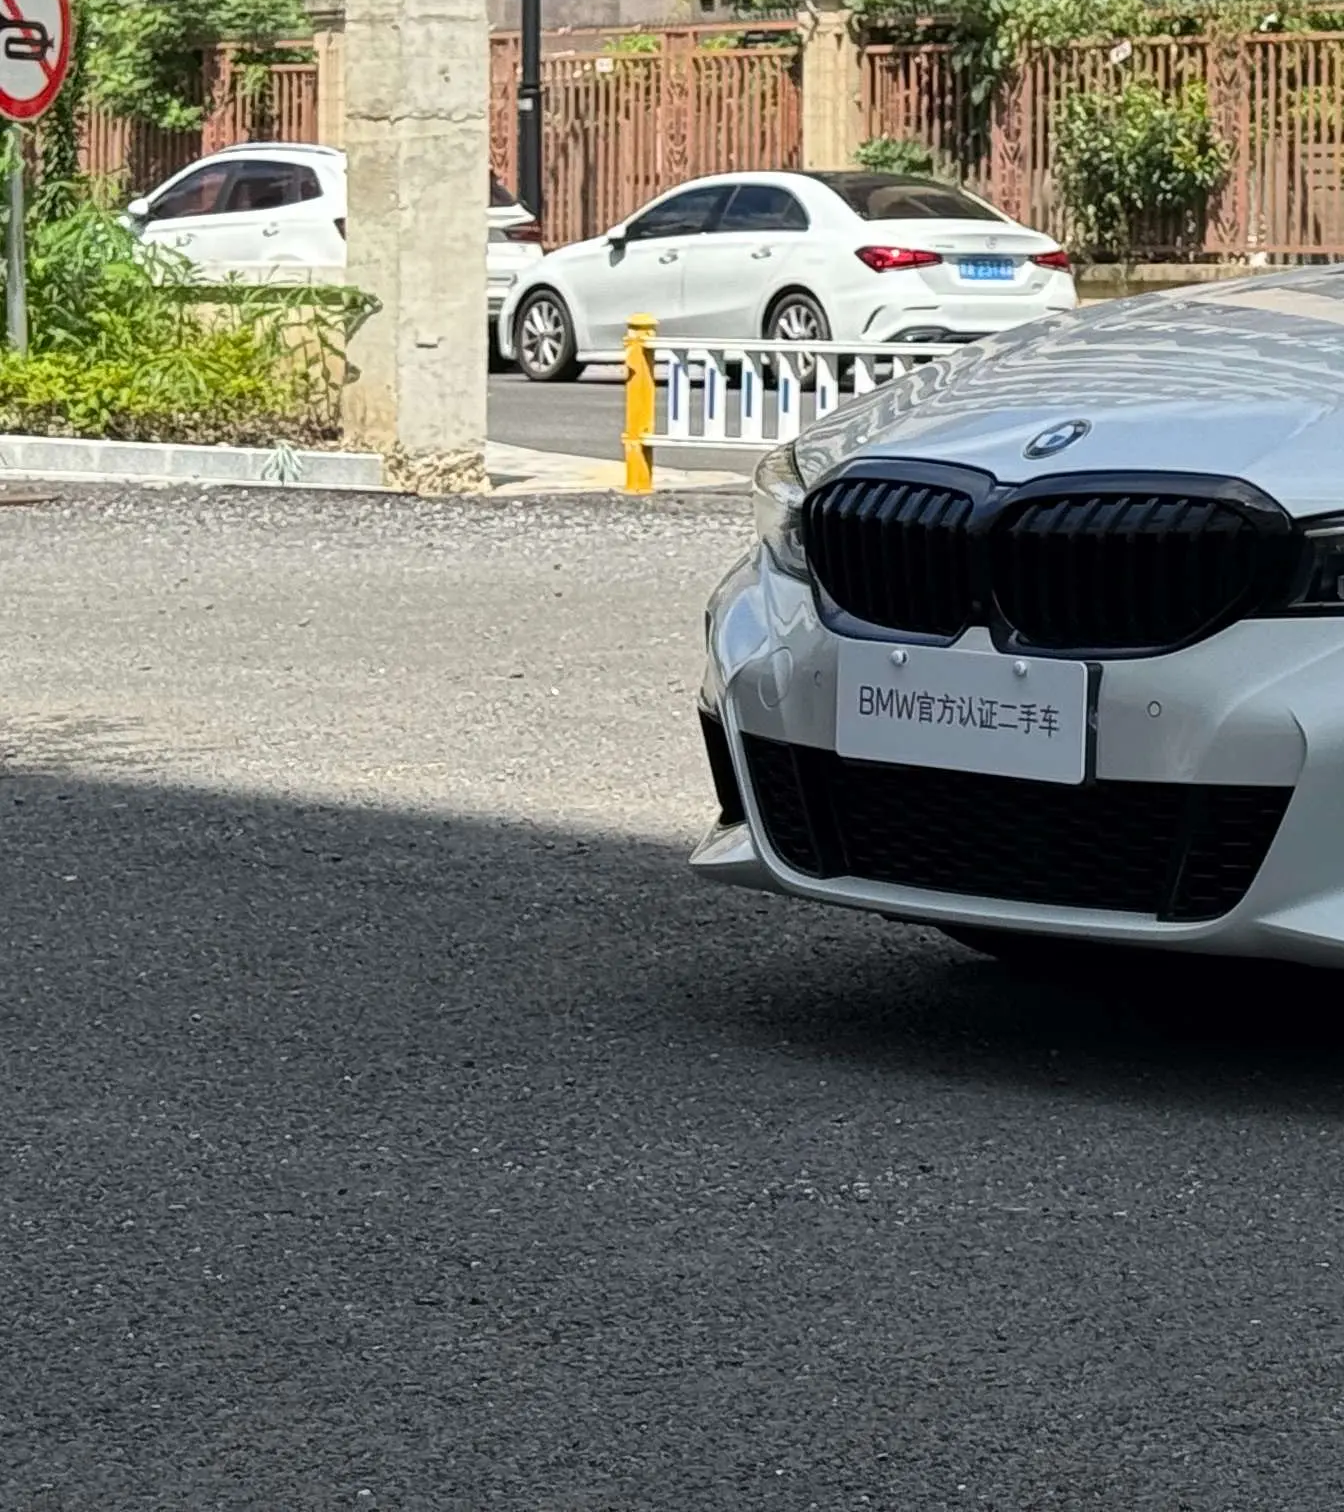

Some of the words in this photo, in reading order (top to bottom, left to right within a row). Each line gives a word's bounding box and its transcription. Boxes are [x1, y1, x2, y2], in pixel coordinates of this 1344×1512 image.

[860, 686, 1059, 737] BMW官方认证二手车
